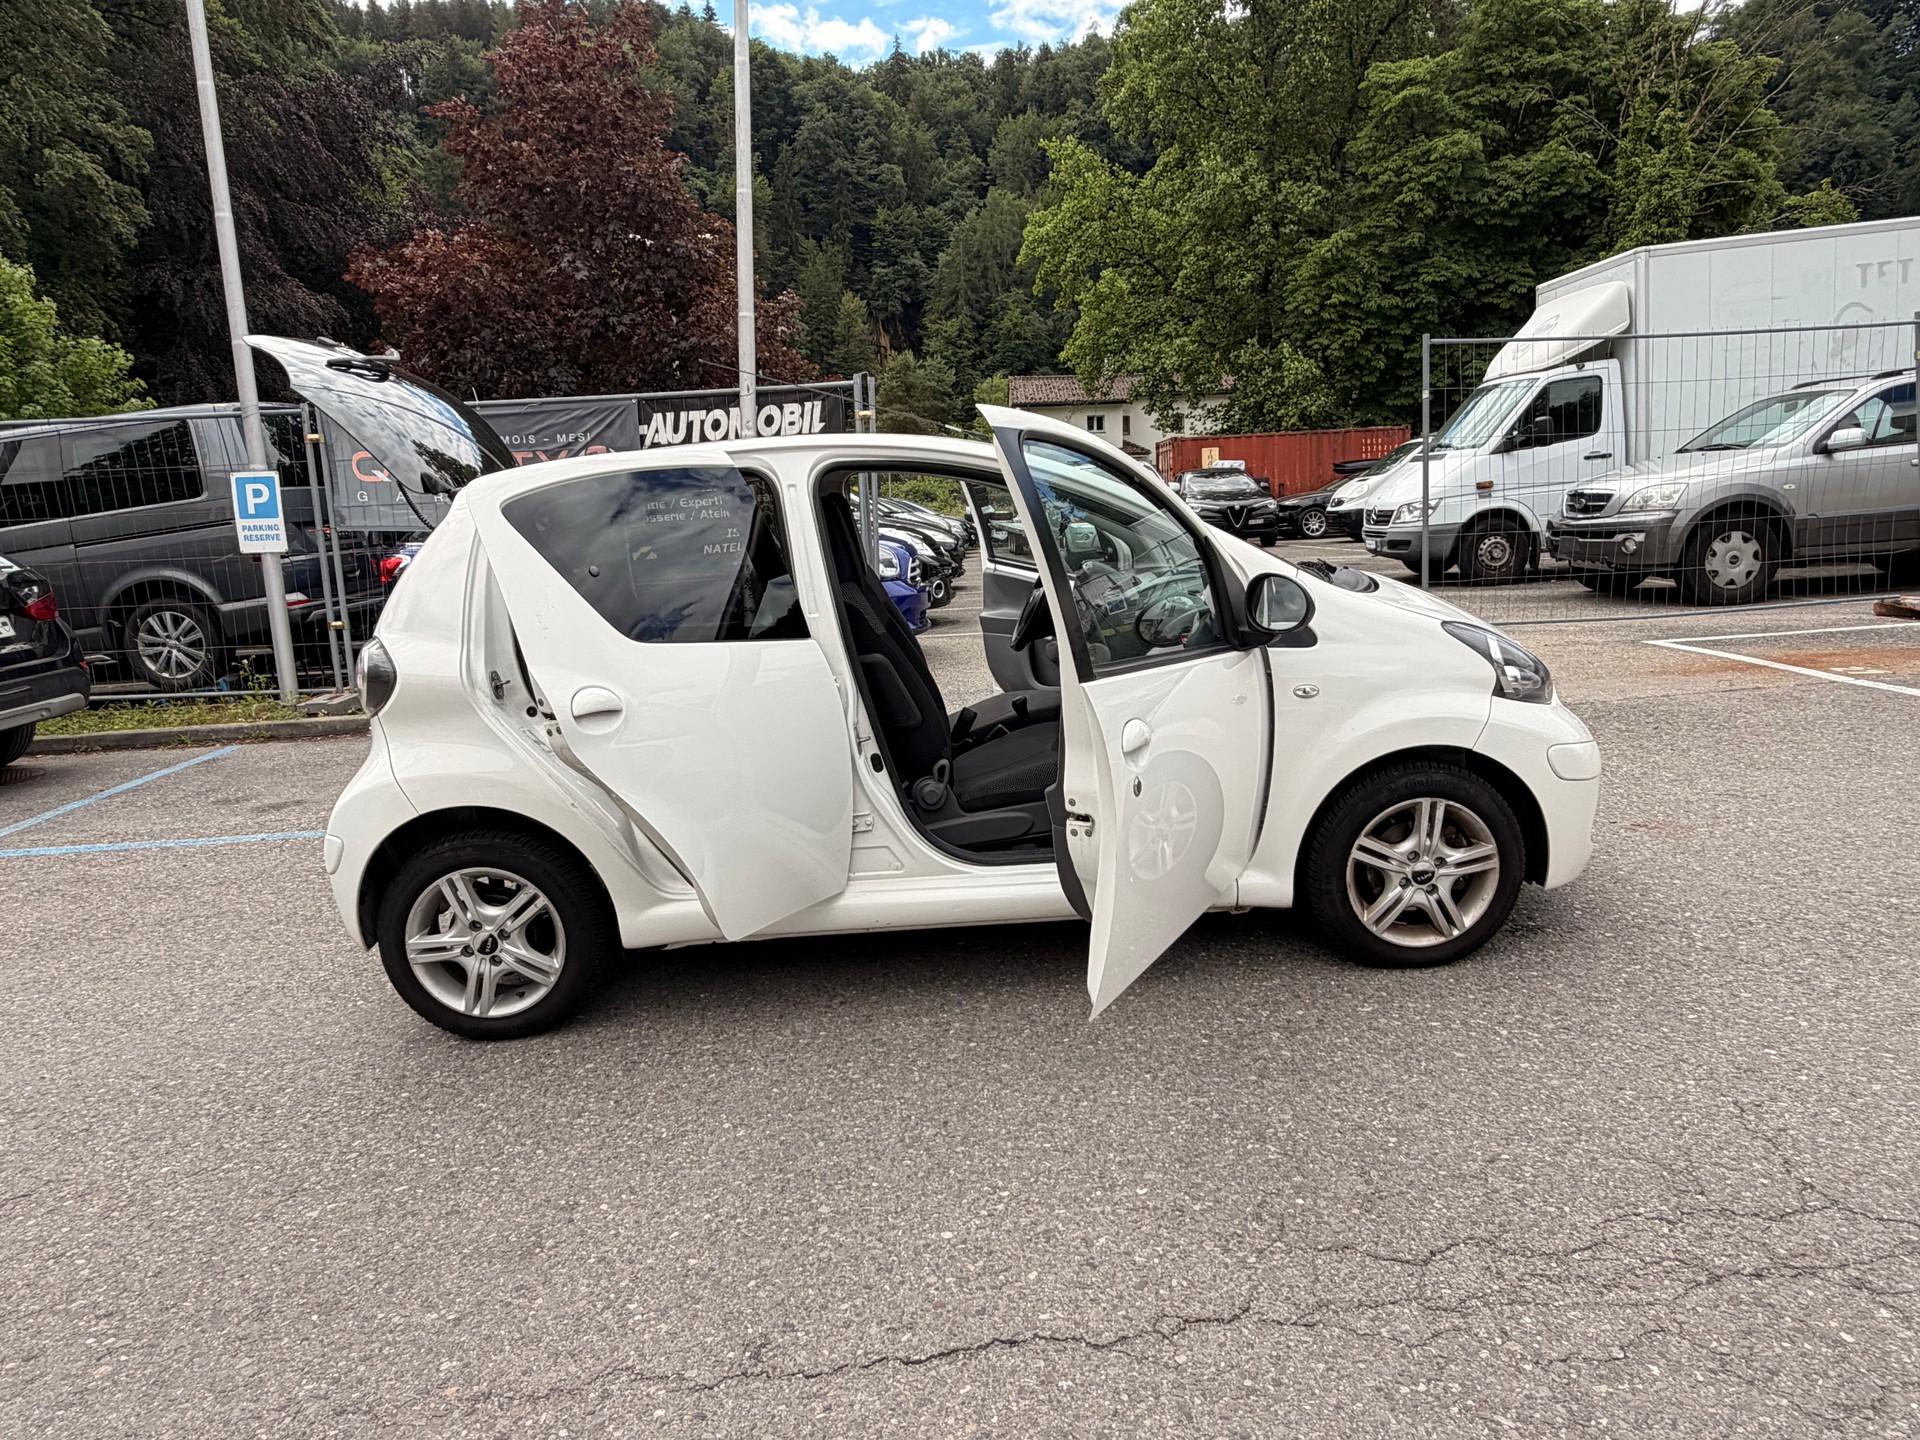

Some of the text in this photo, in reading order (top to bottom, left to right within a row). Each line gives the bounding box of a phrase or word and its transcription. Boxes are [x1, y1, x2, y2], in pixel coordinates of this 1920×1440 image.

[245, 483, 270, 514] P
[242, 524, 280, 532] PARKING
[243, 533, 281, 541] RESERVE
